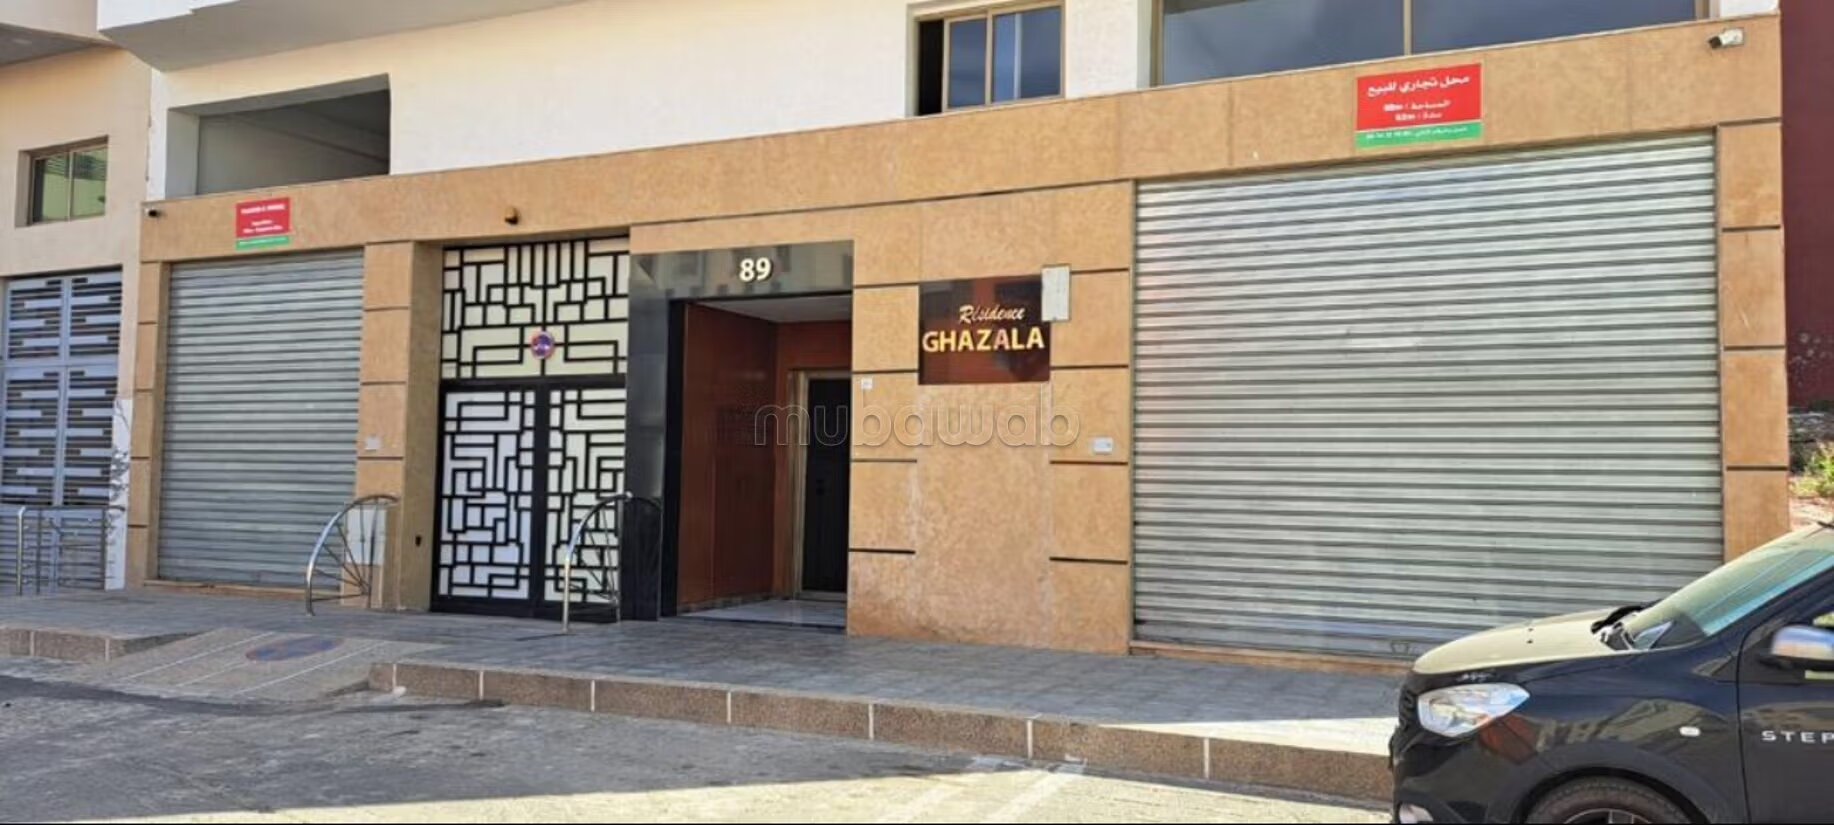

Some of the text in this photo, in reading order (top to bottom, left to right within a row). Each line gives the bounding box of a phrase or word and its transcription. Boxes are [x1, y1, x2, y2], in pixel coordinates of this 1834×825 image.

[1440, 76, 1470, 88] محل
[740, 257, 771, 281] 89
[922, 326, 1045, 352] GHAZALA
